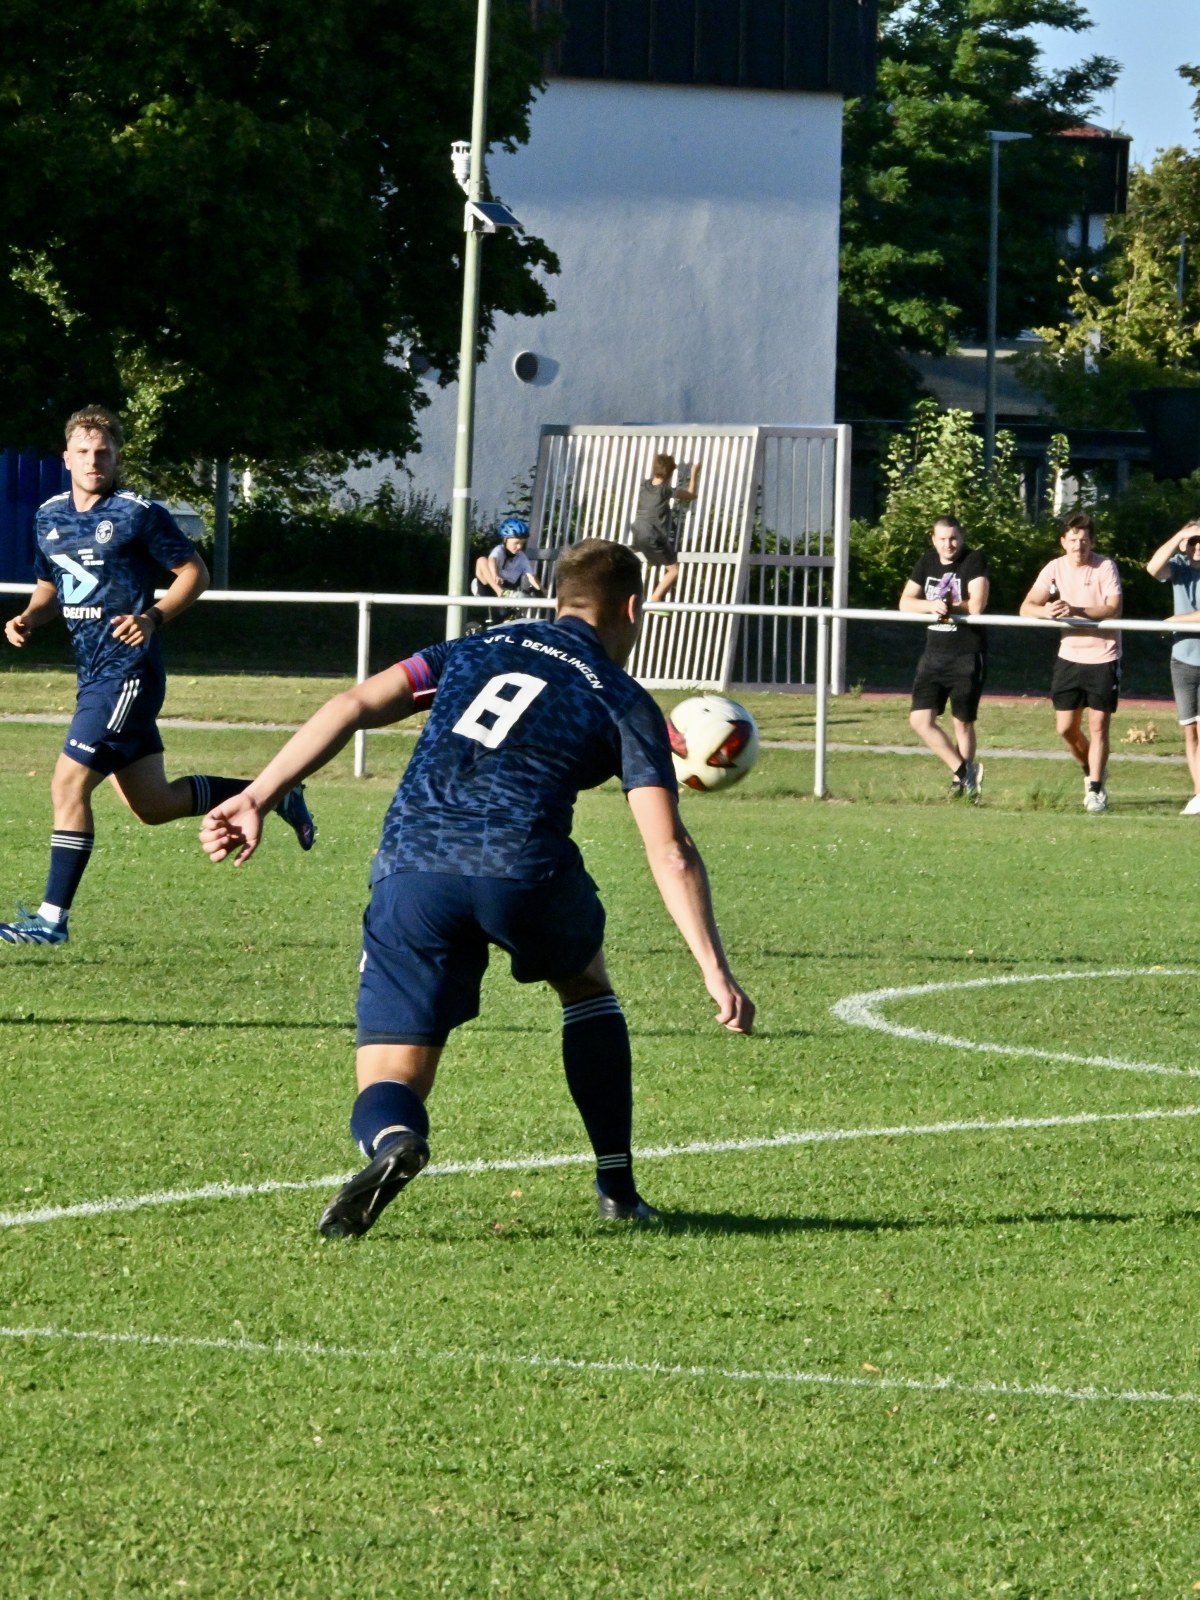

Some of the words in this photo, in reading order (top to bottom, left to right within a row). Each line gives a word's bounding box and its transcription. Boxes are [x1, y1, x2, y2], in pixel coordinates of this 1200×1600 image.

[63, 606, 102, 619] DELTIN
[521, 639, 604, 689] DENKLINGEN
[452, 672, 548, 749] 8
